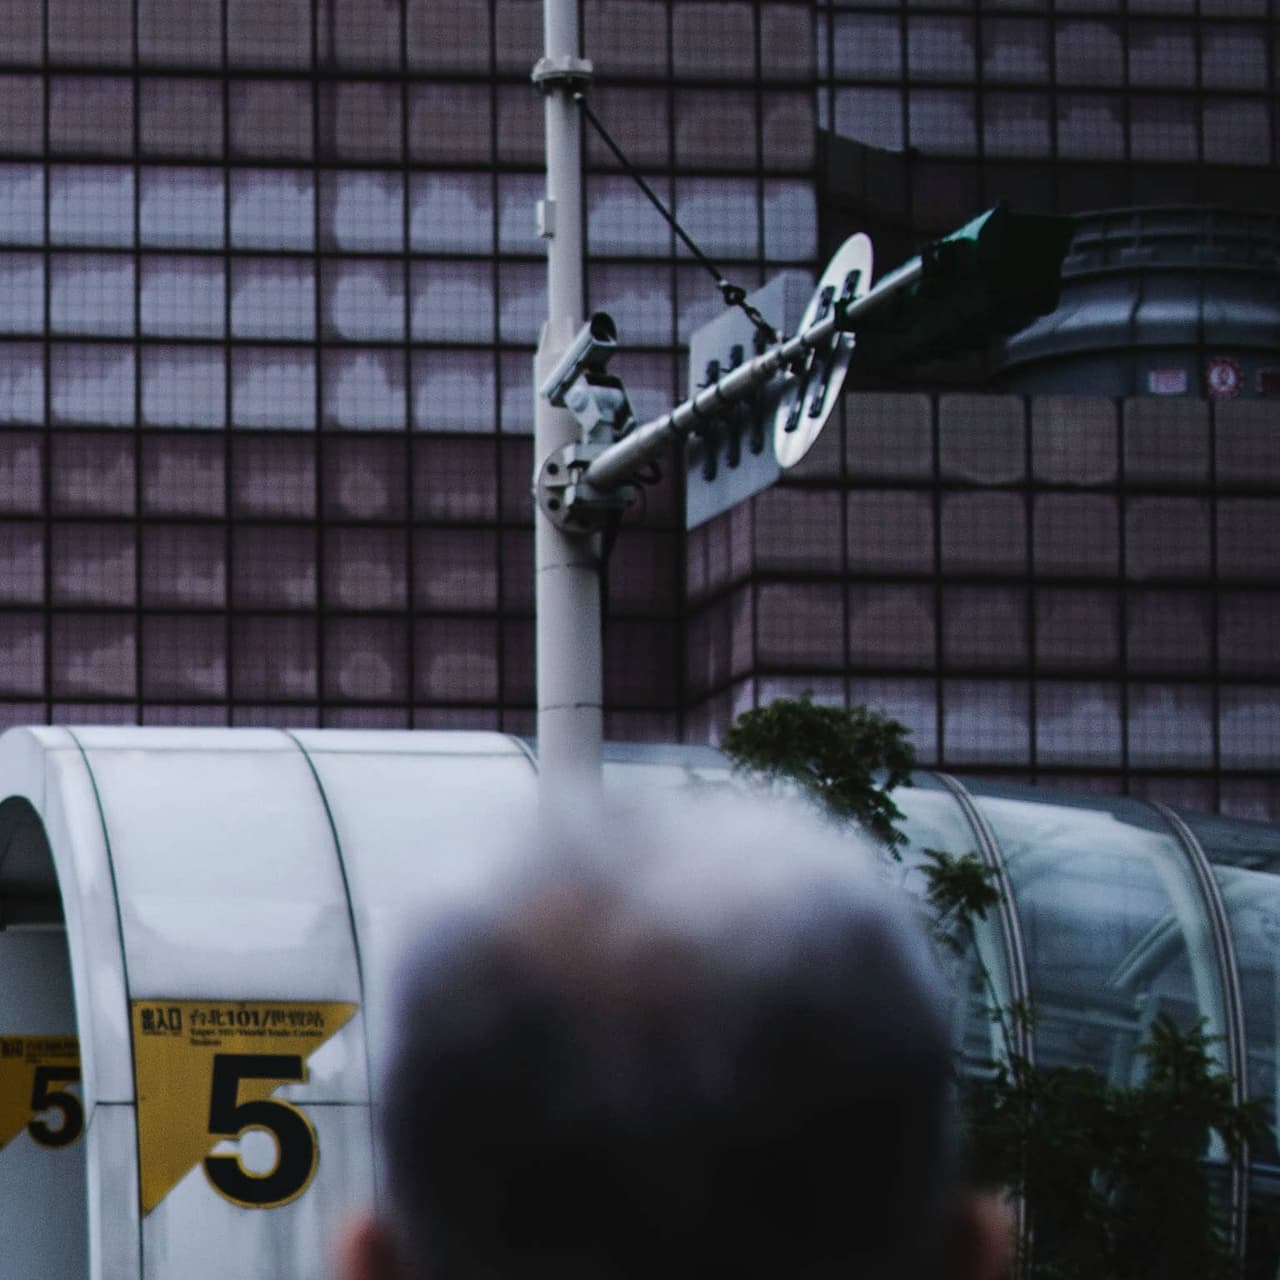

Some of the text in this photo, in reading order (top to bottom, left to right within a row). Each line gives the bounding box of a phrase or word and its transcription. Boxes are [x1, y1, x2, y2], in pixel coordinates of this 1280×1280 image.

[191, 1009, 324, 1027] 台北101/世貿站
[28, 1067, 83, 1148] 5
[204, 1054, 316, 1204] 5
